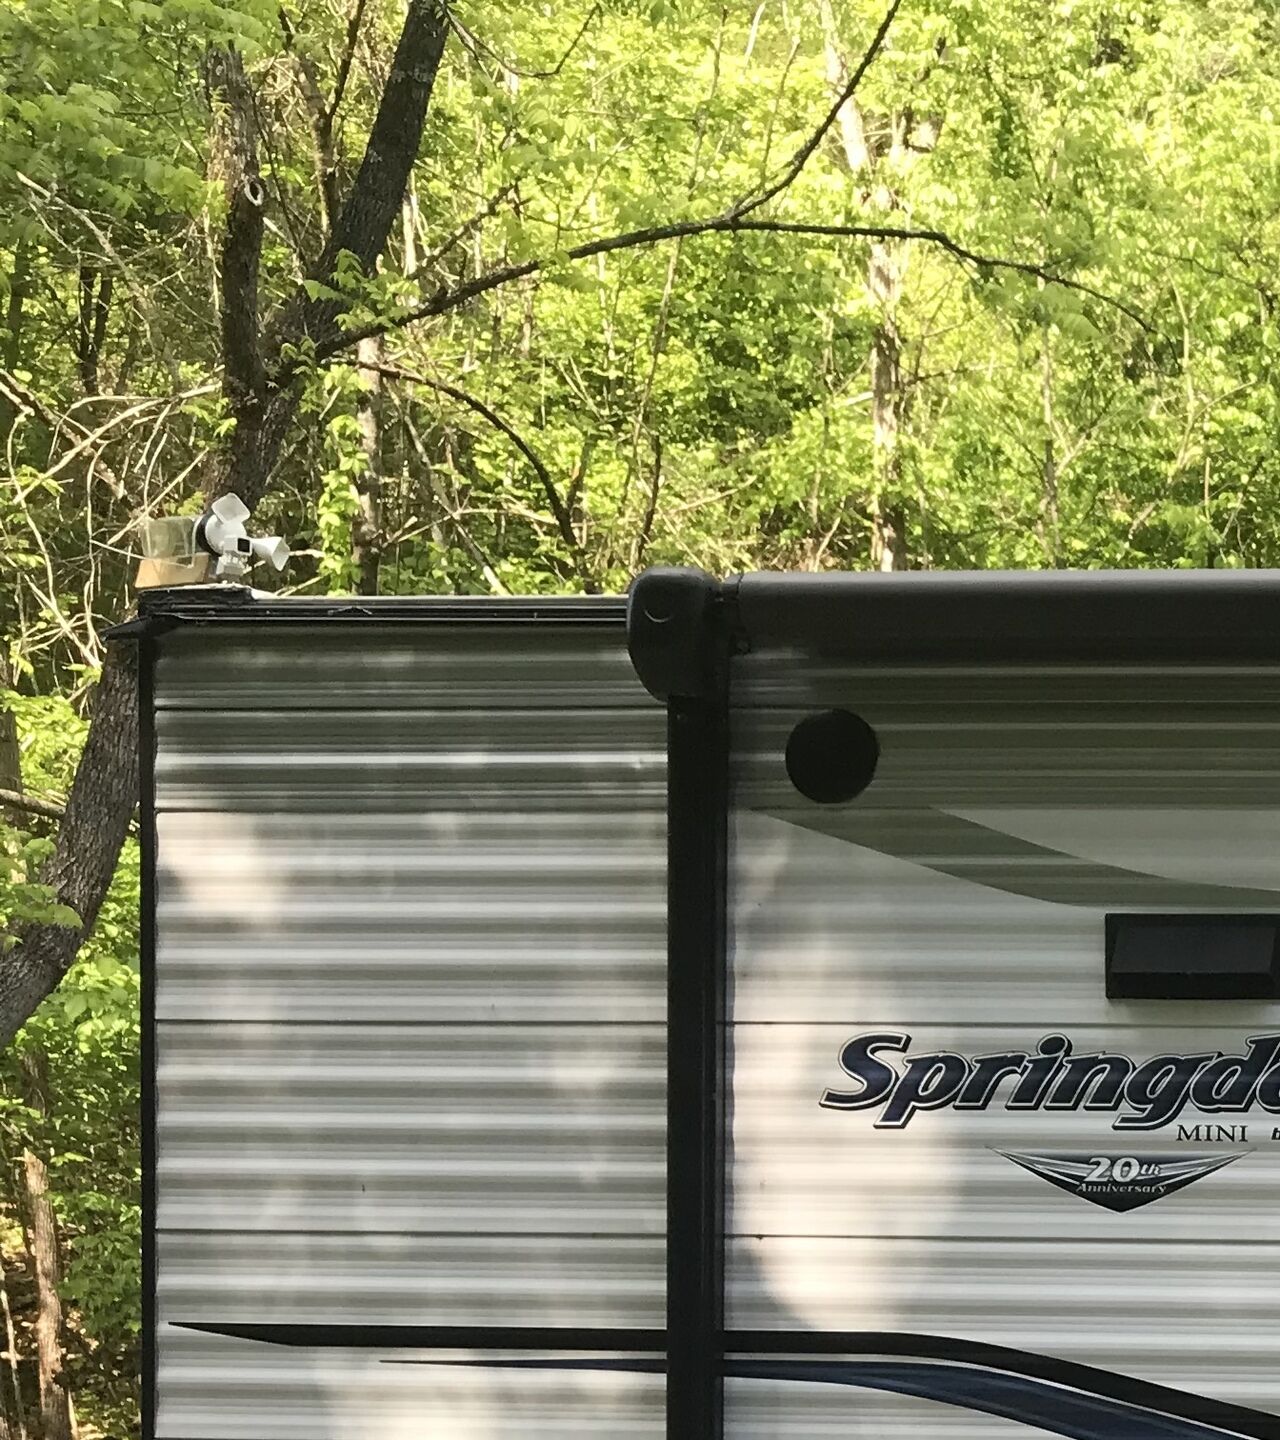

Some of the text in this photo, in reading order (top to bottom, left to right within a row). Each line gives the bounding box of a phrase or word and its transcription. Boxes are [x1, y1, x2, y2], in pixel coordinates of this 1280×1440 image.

[1176, 1124, 1249, 1142] MINI
[1085, 1157, 1161, 1182] 20th
[1075, 1183, 1167, 1194] Anniversary
